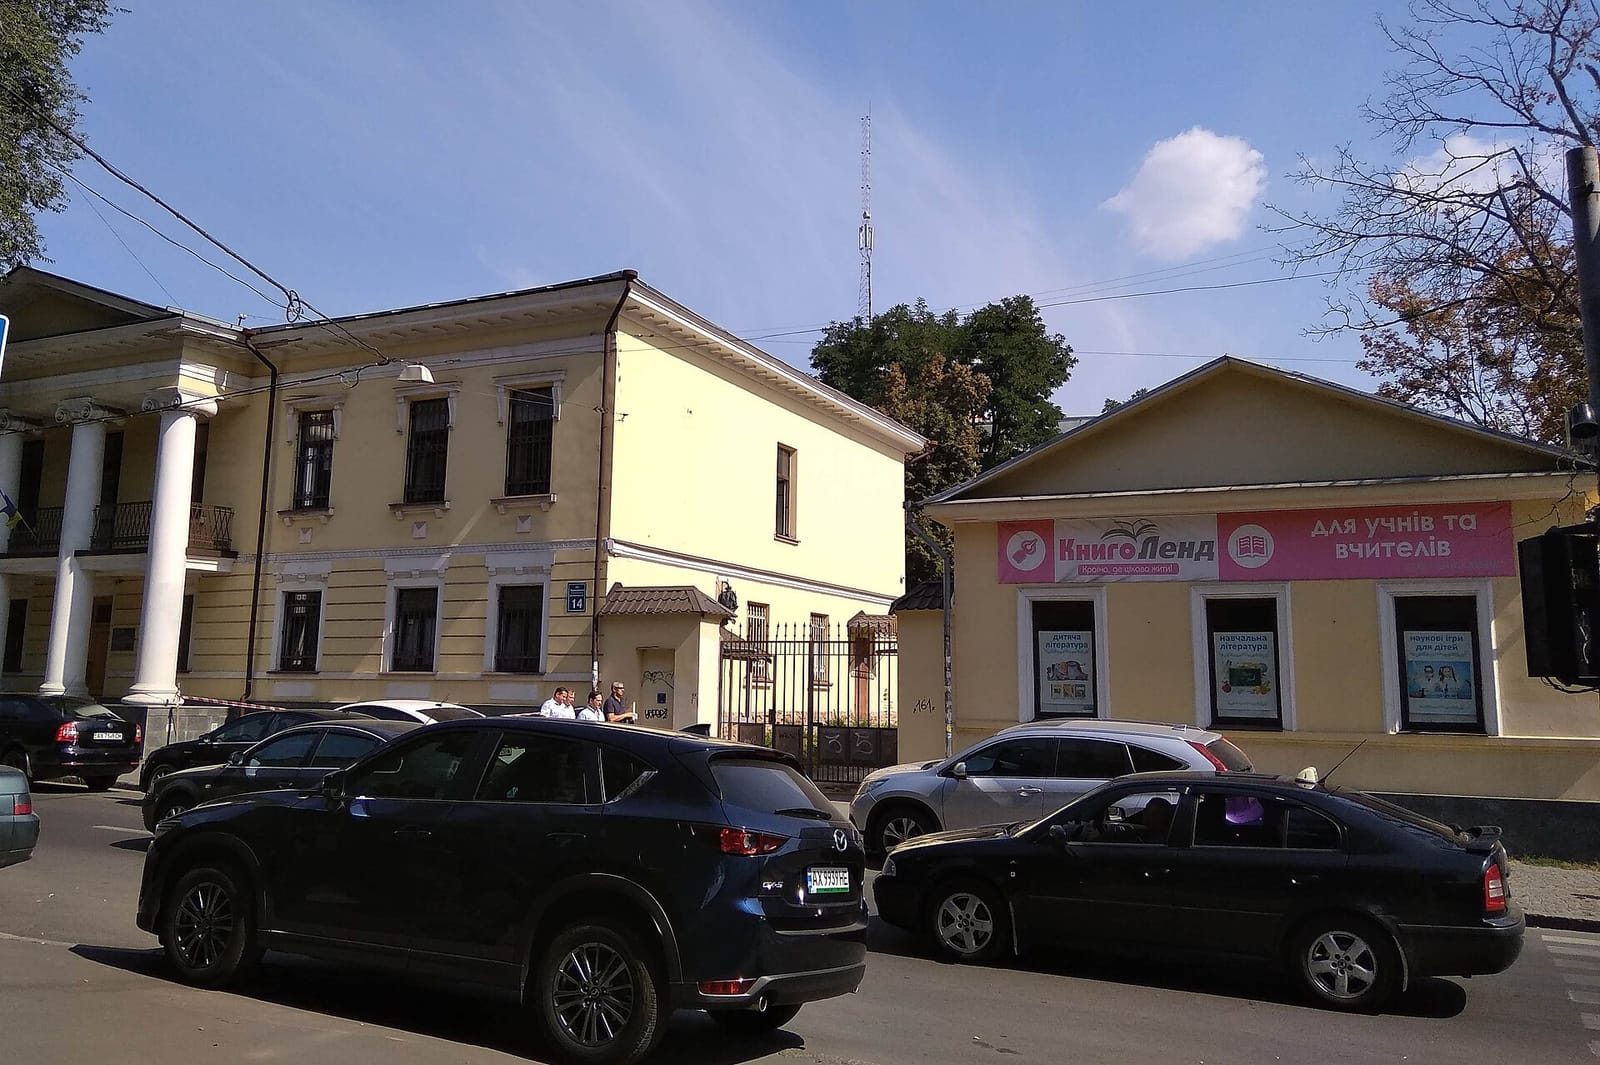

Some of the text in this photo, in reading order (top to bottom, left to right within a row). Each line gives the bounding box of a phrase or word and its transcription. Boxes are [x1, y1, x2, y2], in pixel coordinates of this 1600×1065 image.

[1312, 511, 1477, 538] для учнів та
[1059, 535, 1215, 562] КнигоЛенд
[1335, 536, 1452, 559] вчителів
[571, 598, 583, 609] 14
[1445, 634, 1464, 643] ігри
[1045, 641, 1088, 650] література
[1220, 642, 1268, 651] література
[1434, 643, 1458, 651] дітей
